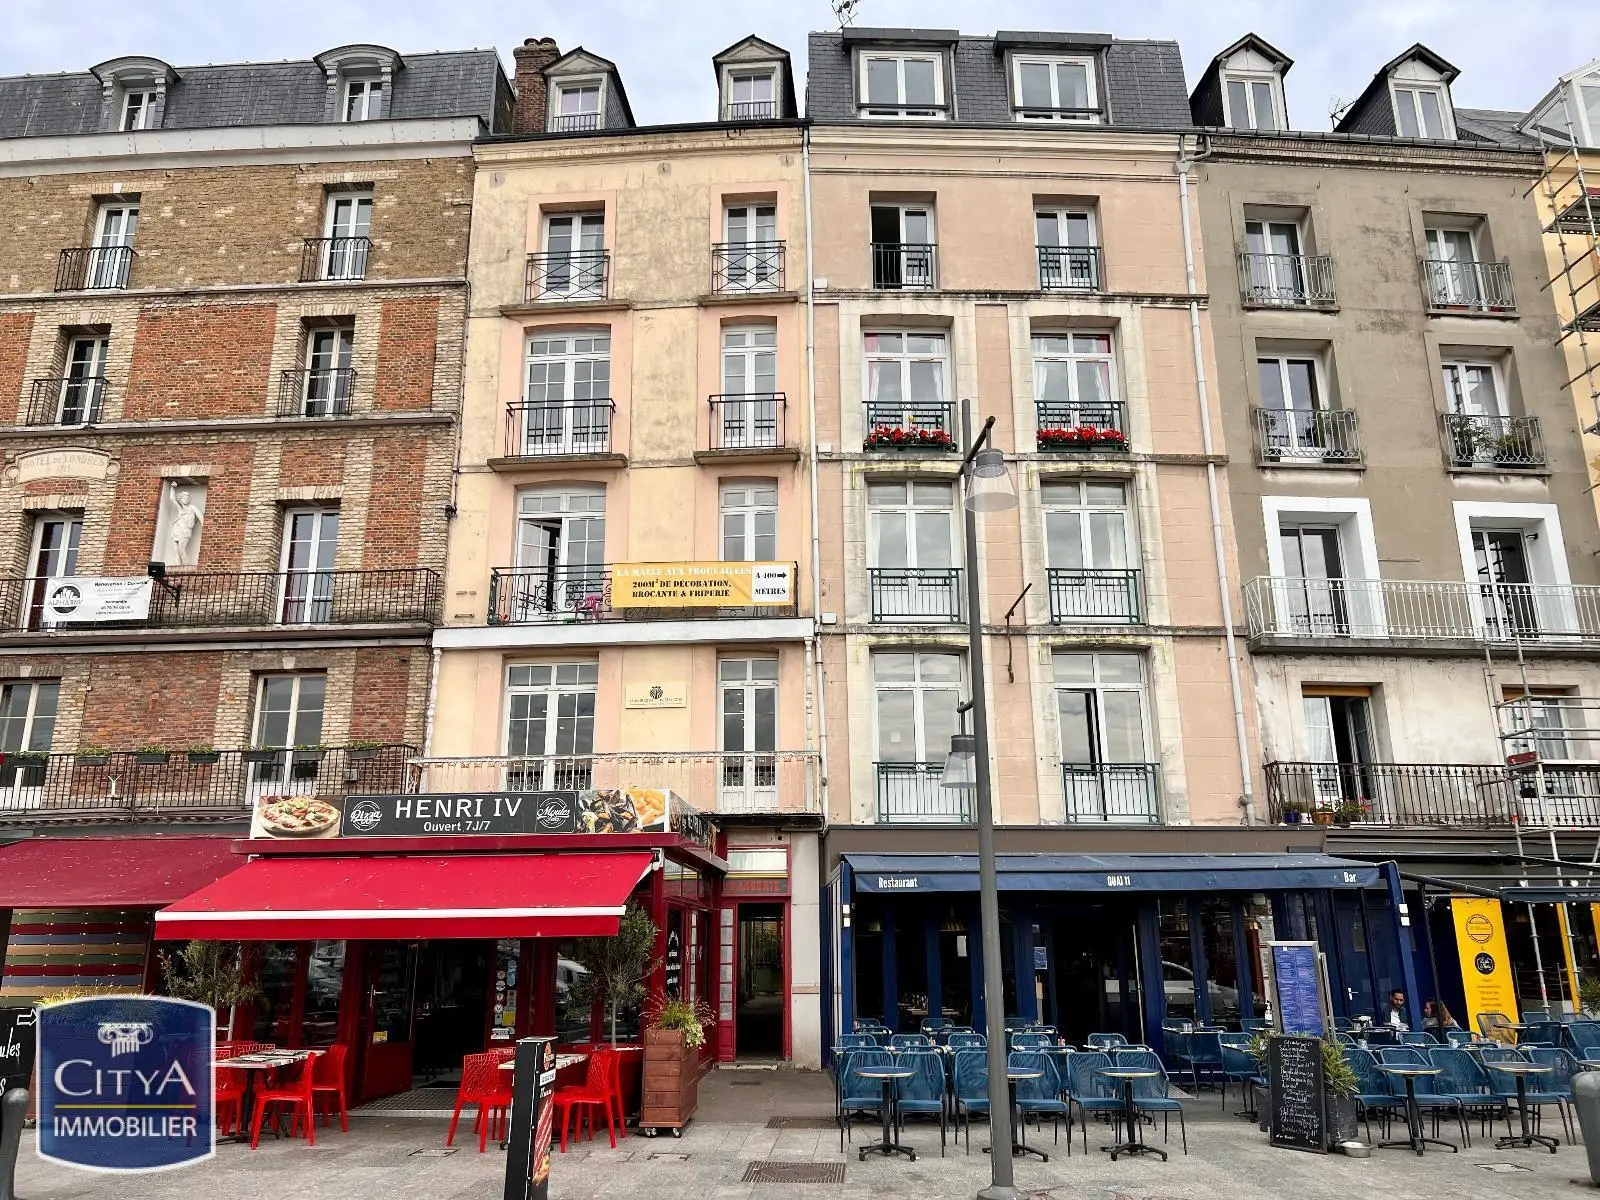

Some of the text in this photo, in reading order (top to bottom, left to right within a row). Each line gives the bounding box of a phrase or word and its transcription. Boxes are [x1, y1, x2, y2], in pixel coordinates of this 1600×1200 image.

[616, 566, 752, 577] LA MALLE AUX TROUVAILLES
[632, 590, 678, 598] BROCANTE
[689, 589, 730, 597] FRIPERIE
[395, 798, 522, 819] HENRI IV
[537, 805, 570, 820] Moules
[351, 809, 382, 823] Pizza
[423, 820, 491, 832] Ouvert 7J/7
[878, 871, 1357, 888] Restaurant QUAI 11 Bar
